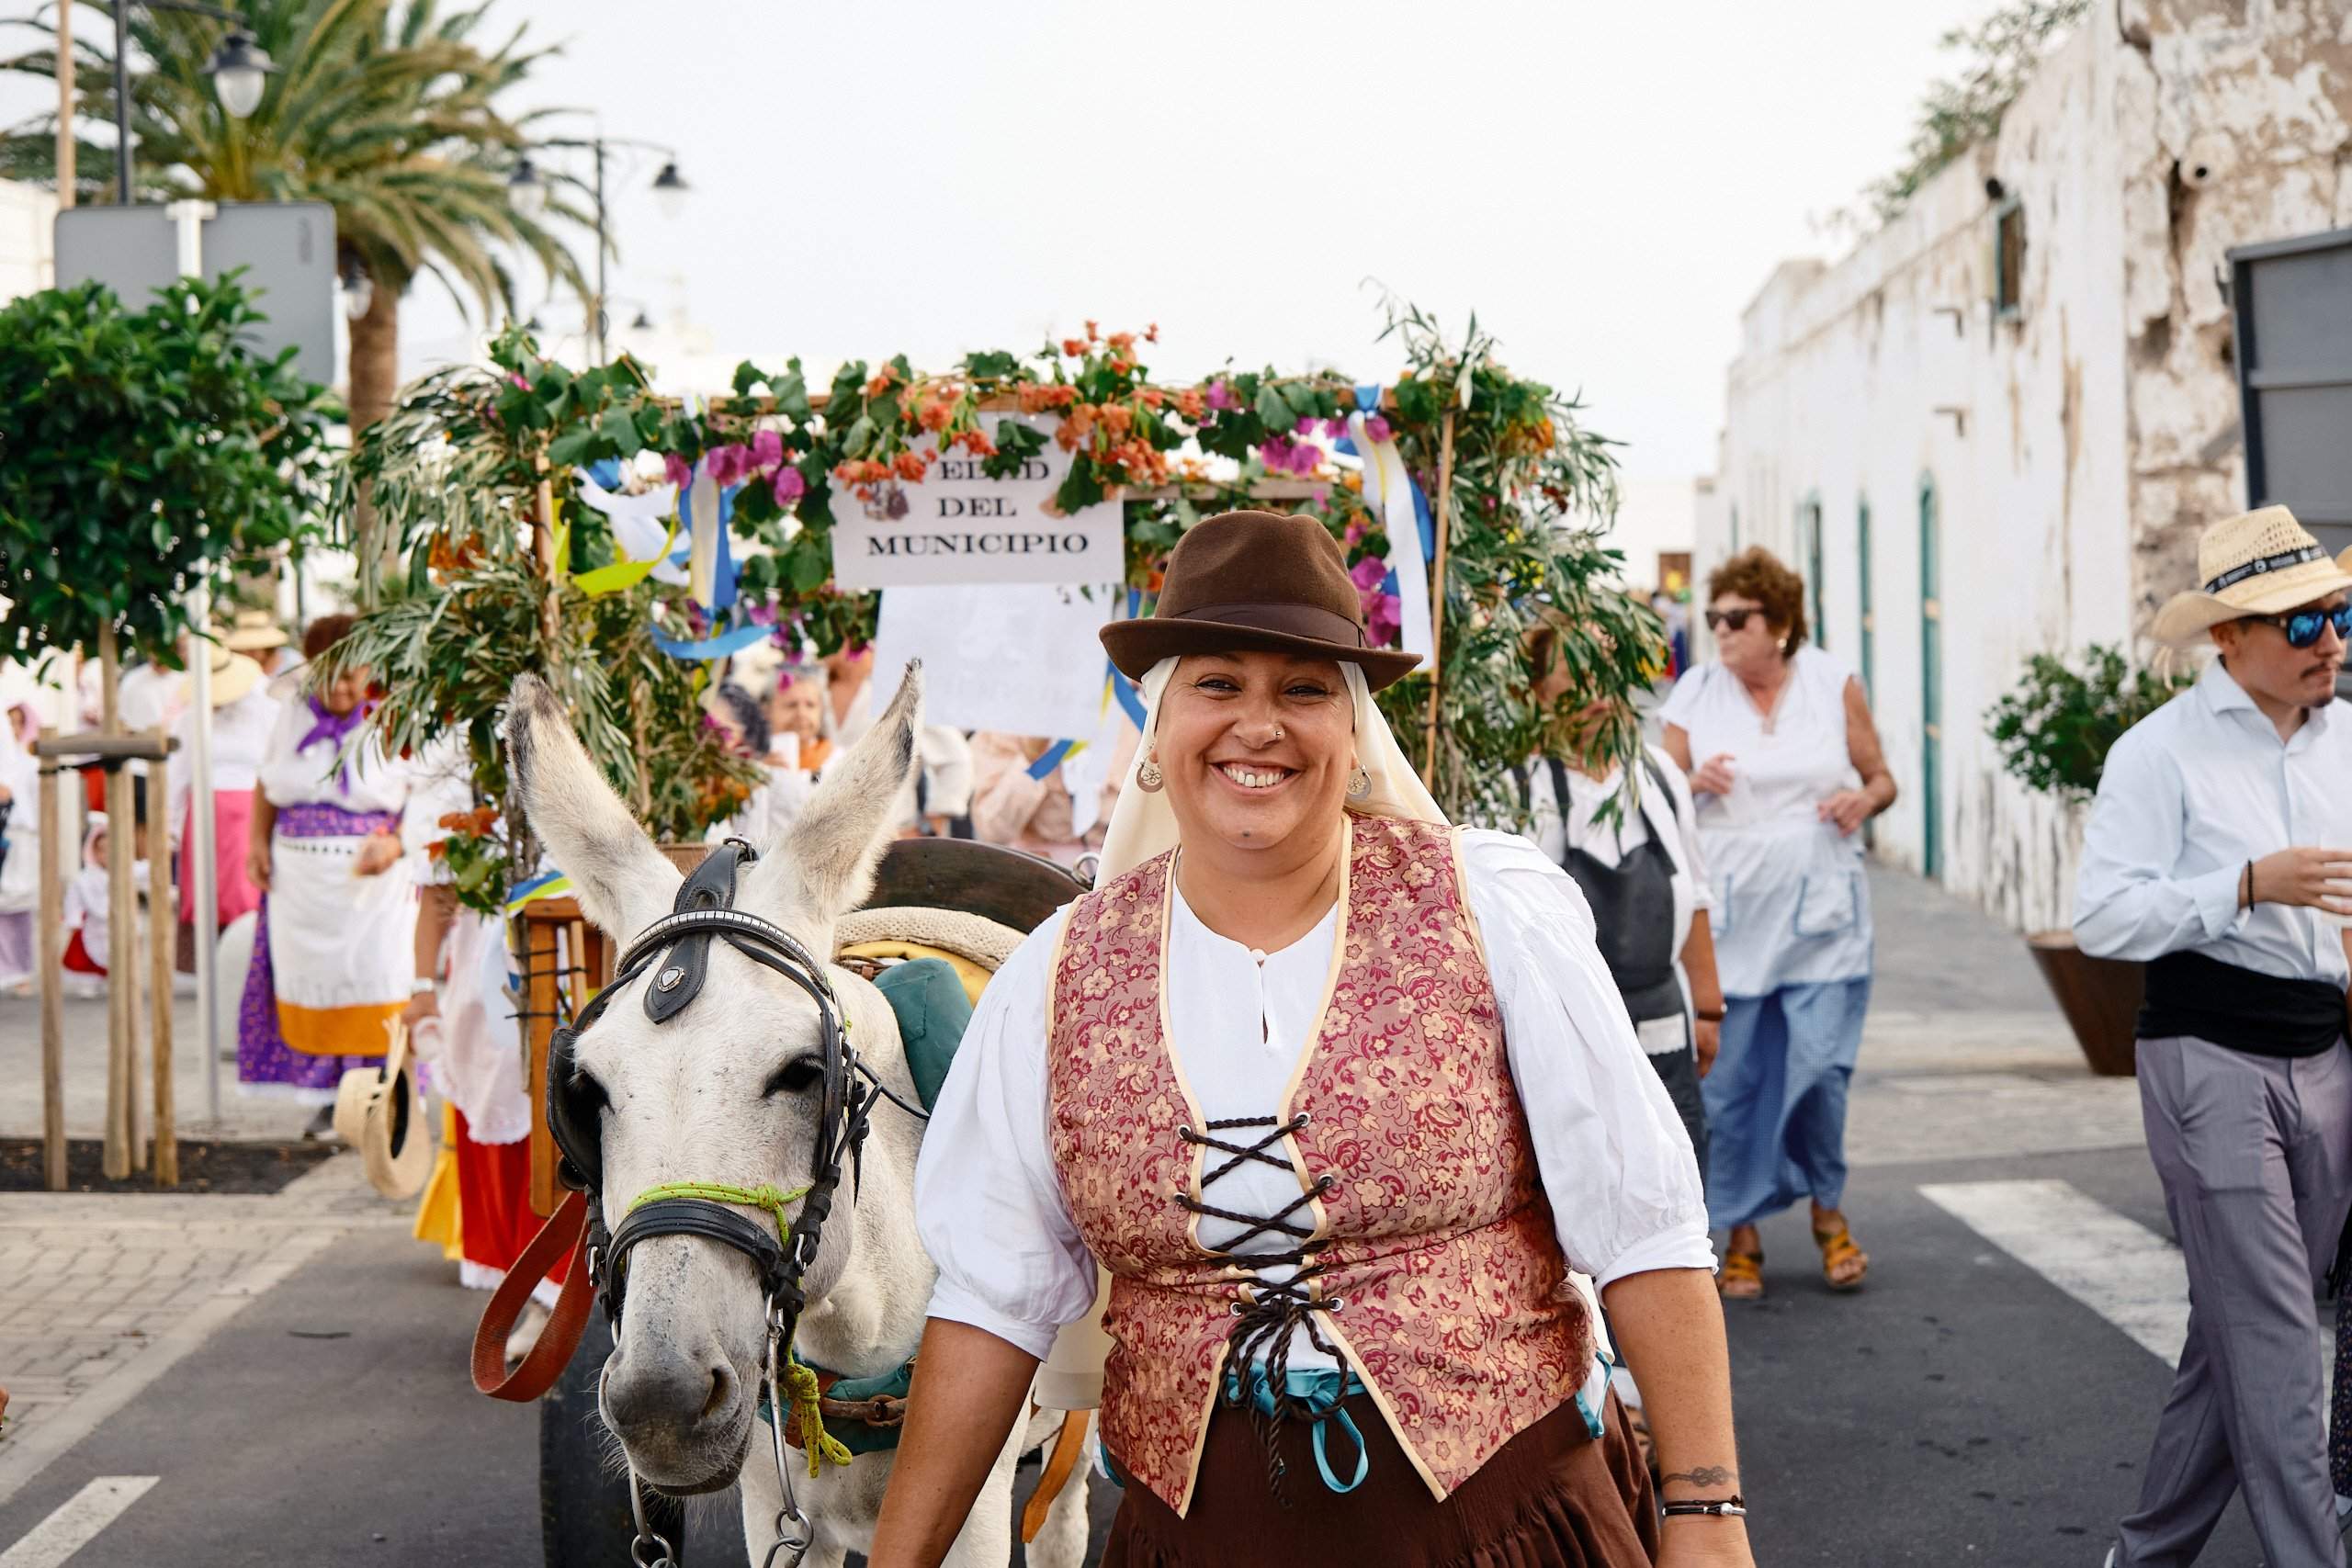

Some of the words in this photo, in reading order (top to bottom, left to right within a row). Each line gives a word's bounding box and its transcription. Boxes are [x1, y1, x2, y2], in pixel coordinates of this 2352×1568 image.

[939, 460, 1050, 479] ED
[937, 497, 1017, 516] DEL
[868, 534, 1089, 556] MUNICIPIO
